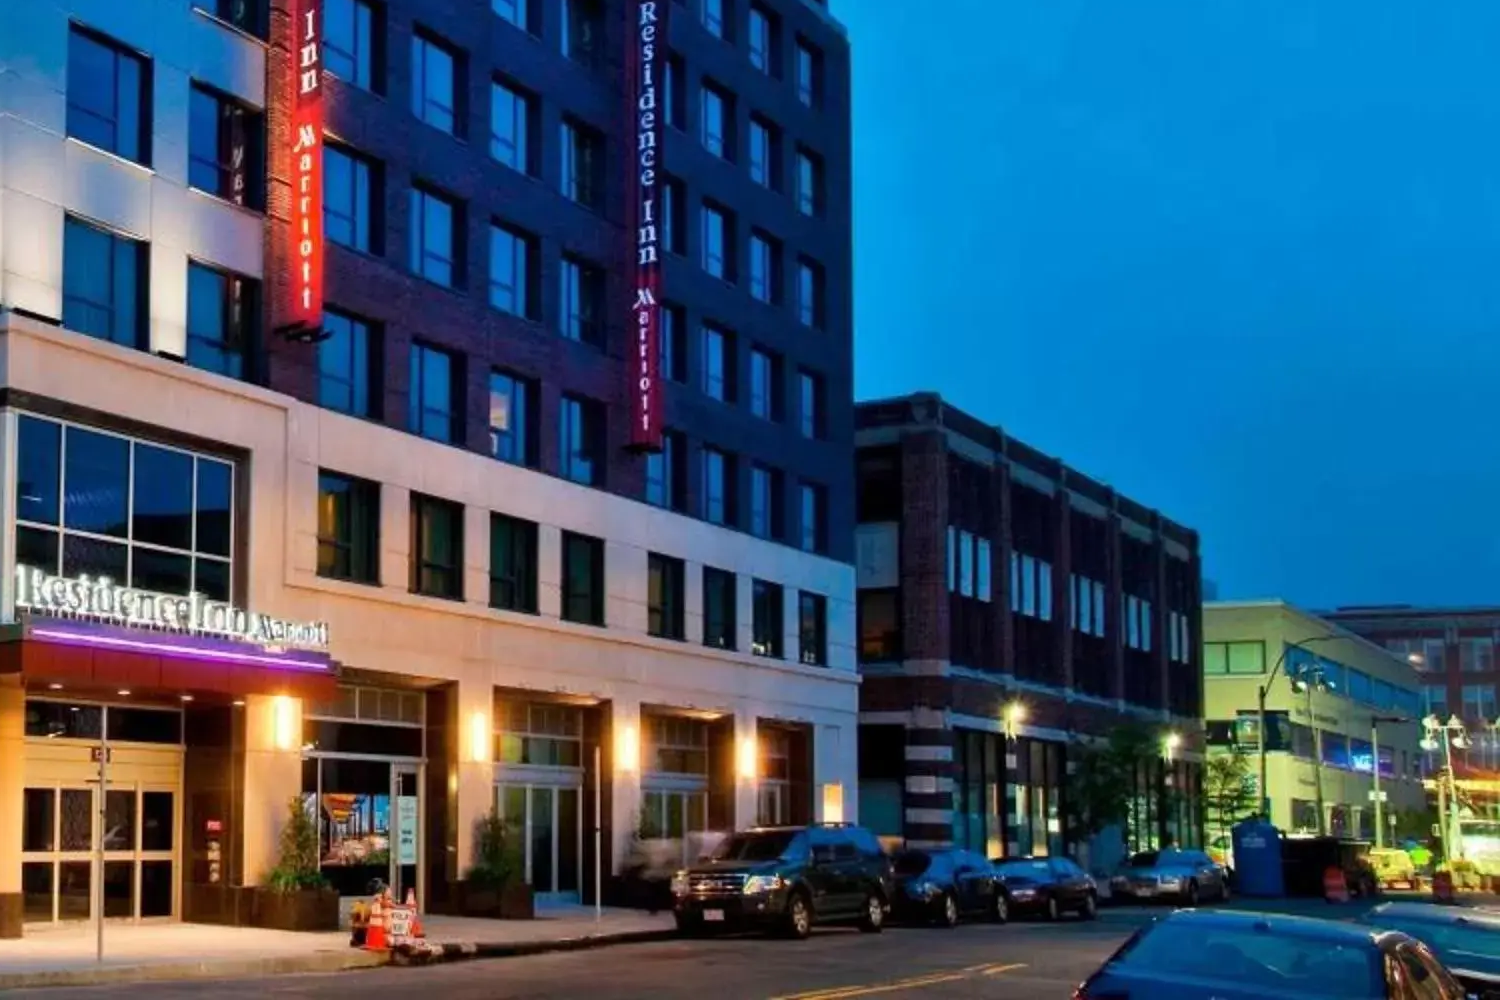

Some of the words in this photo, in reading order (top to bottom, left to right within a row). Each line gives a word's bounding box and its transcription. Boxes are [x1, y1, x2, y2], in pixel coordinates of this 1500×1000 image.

[300, 11, 318, 94] Inn
[638, 1, 657, 186] Residence
[294, 124, 316, 309] Marriott
[638, 200, 657, 265] Inn
[633, 288, 656, 431] Marriott
[15, 563, 190, 627] Residence
[189, 591, 248, 637] Inn
